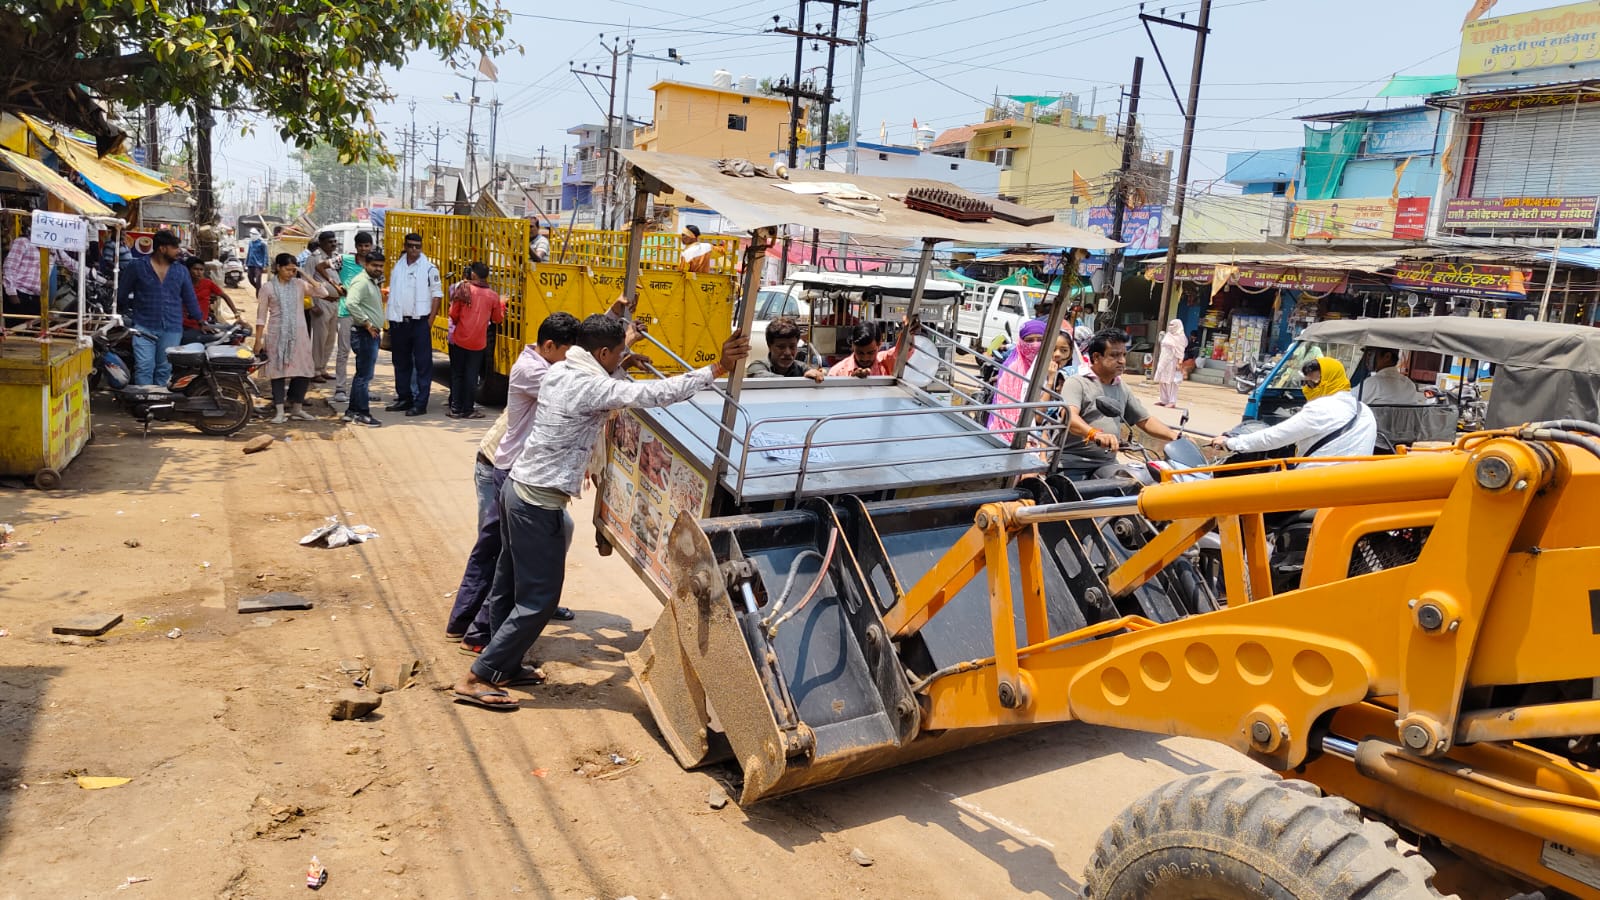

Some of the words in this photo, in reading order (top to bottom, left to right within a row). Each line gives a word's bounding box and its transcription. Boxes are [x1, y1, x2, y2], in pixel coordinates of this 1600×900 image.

[1472, 23, 1508, 44] राशी
[1448, 209, 1464, 218] राशी
[1512, 207, 1538, 218] सेनेटरी
[1541, 209, 1556, 218] एण्ड
[44, 231, 57, 241] 70
[539, 272, 567, 289] STOP
[1240, 270, 1252, 279] माँ
[1397, 263, 1433, 281] राशी
[1432, 264, 1511, 286] इलेक्ट्रिकल
[593, 274, 598, 284] 5
[650, 280, 673, 290] बनाकर
[694, 351, 716, 363] Stop
